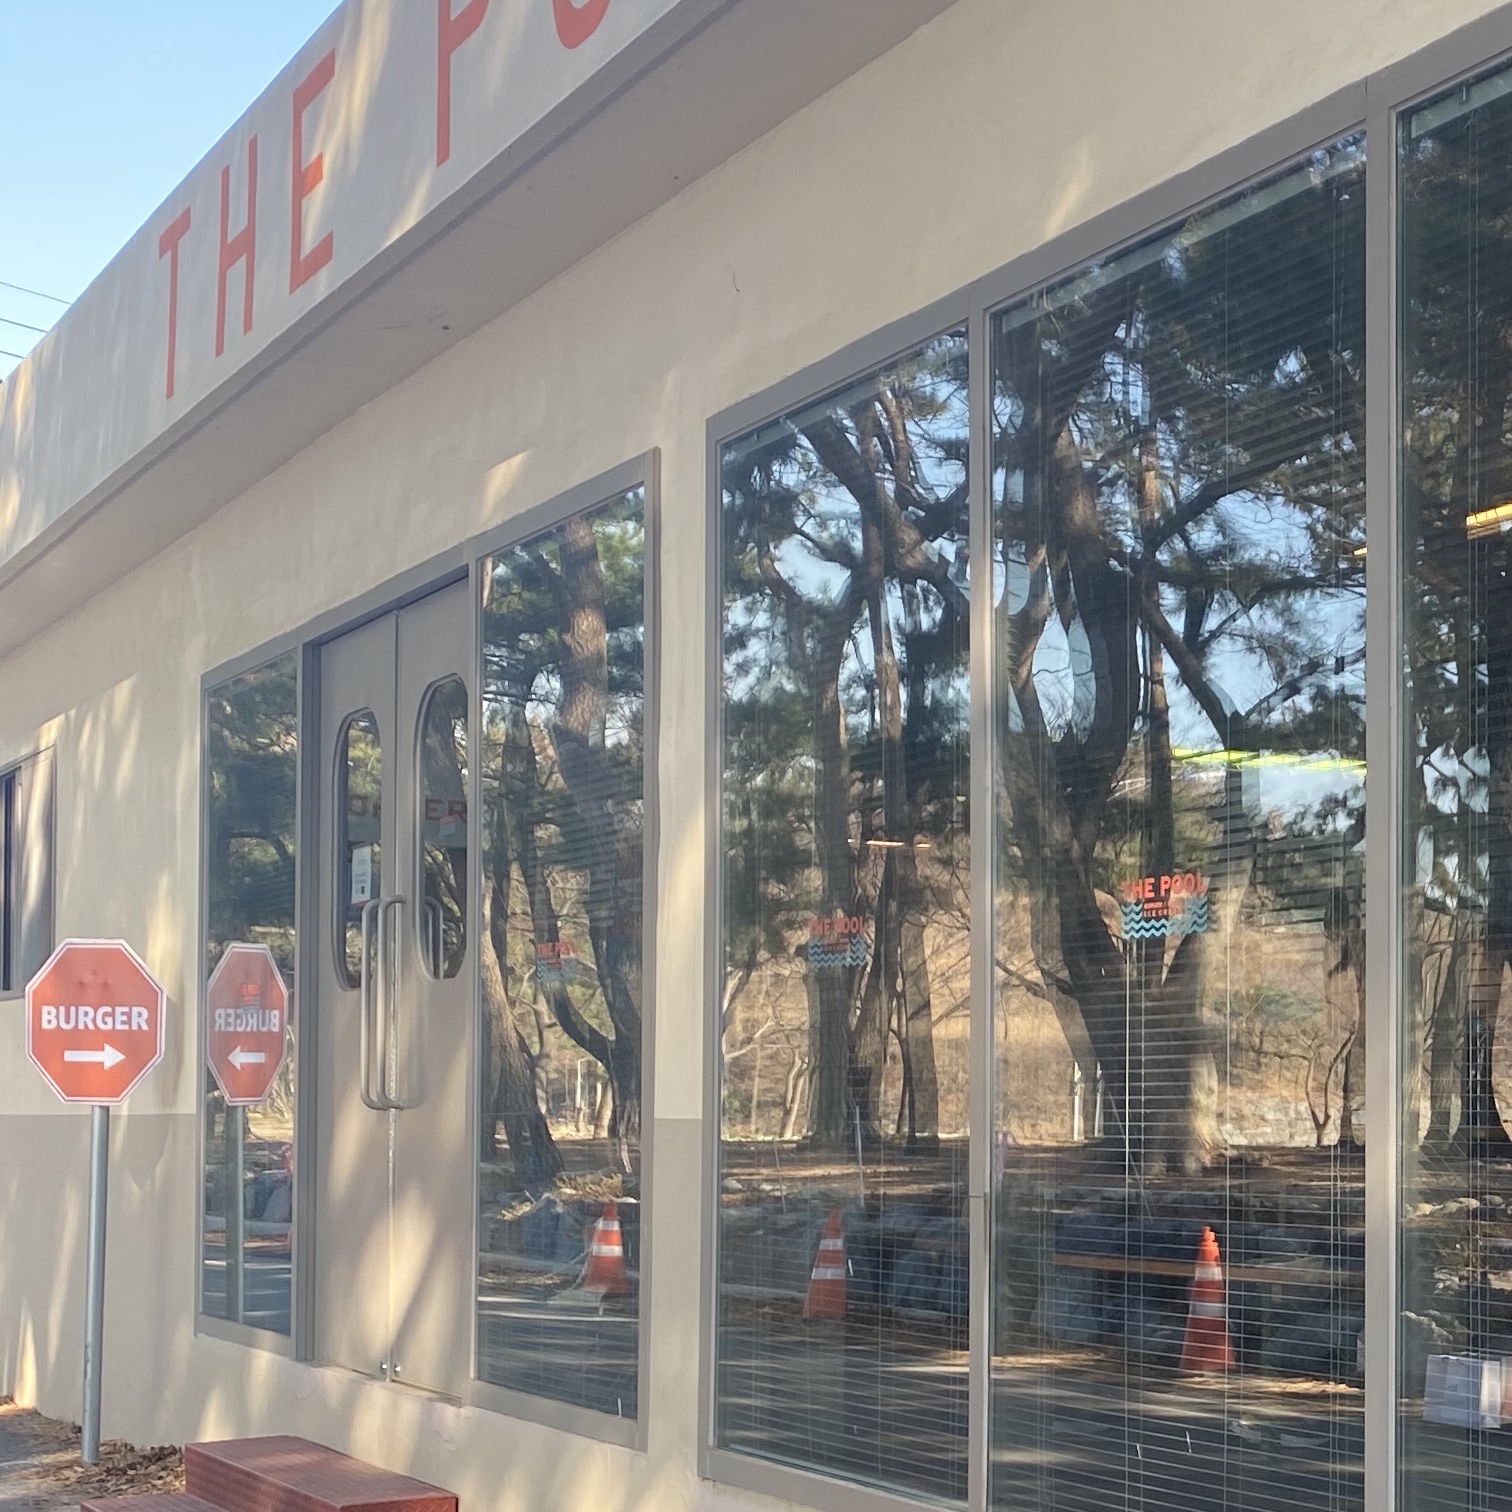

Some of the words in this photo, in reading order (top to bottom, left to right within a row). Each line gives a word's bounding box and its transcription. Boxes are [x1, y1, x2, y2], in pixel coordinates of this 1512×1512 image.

[159, 49, 335, 399] THE
[437, 0, 611, 168] P
[1120, 877, 1156, 901] THE
[1160, 872, 1207, 896] POOL
[41, 1005, 149, 1031] BURGER
